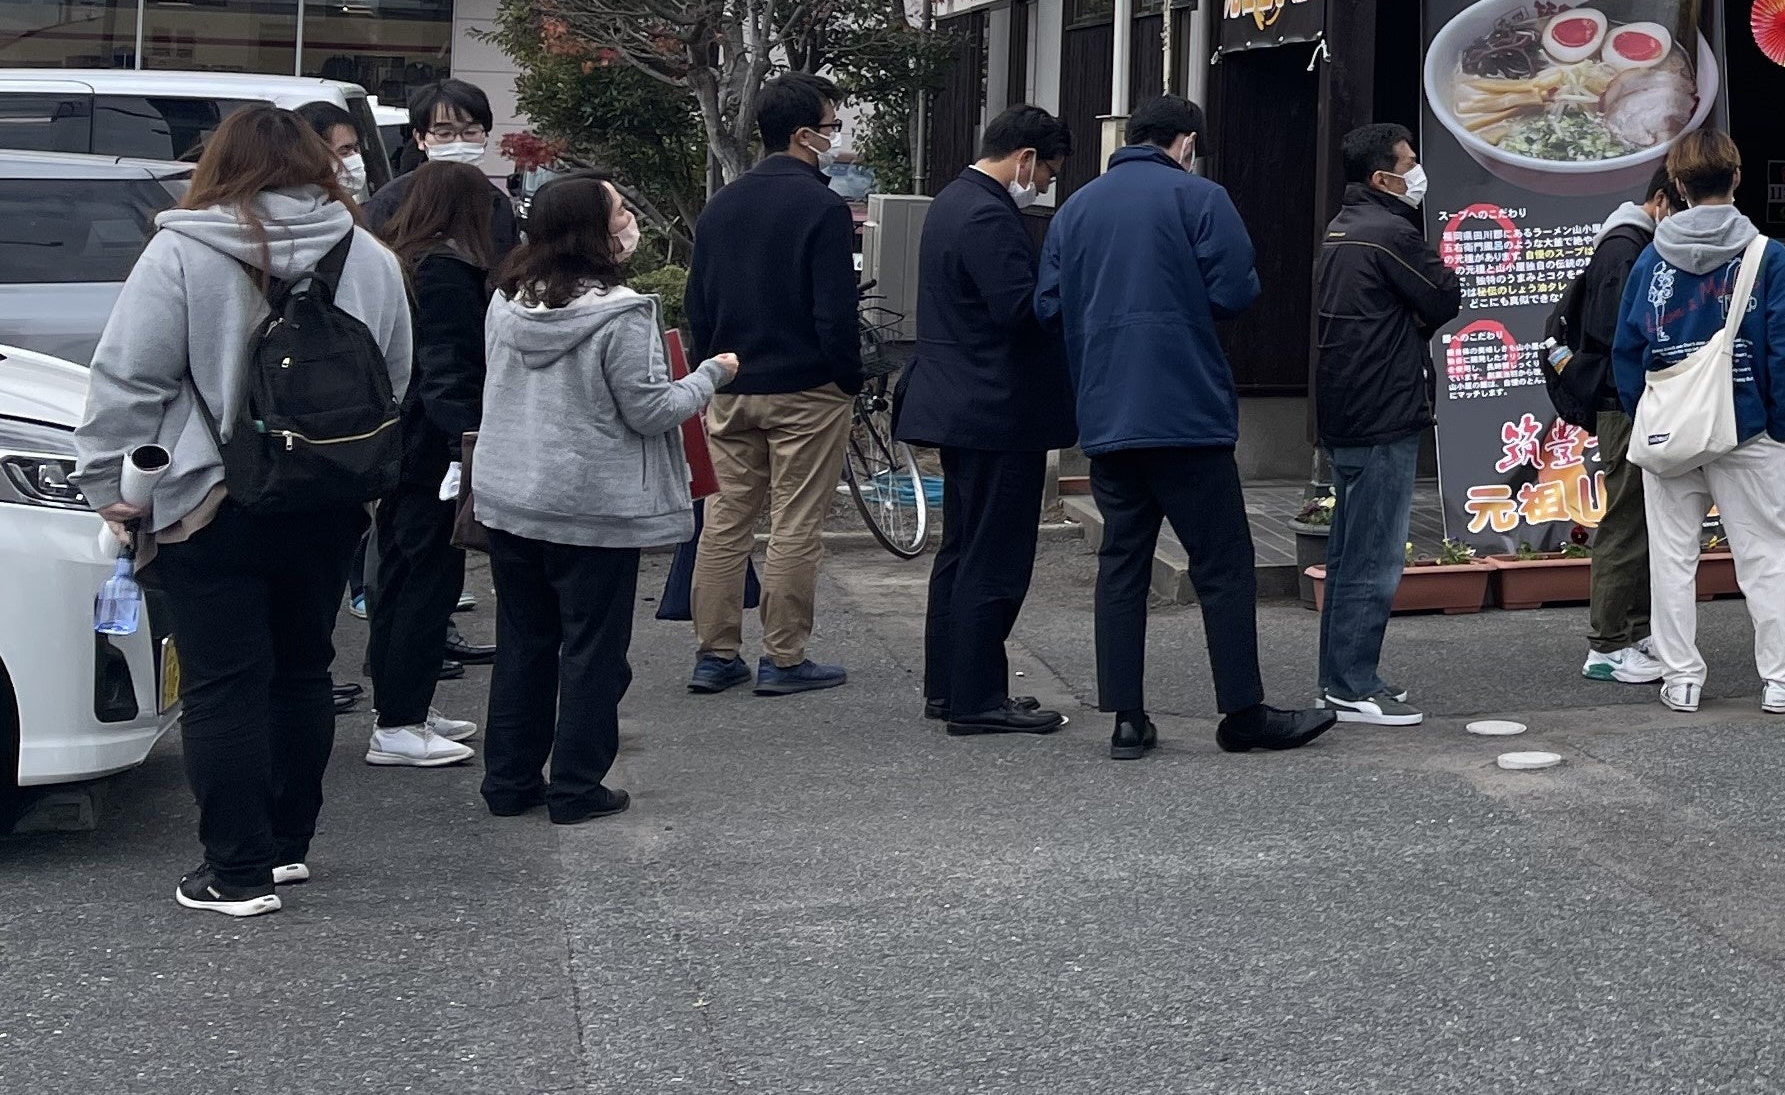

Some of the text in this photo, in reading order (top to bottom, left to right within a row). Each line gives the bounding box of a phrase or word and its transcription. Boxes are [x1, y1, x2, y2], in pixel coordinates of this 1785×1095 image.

[1438, 207, 1527, 221] スープへのこだわり
